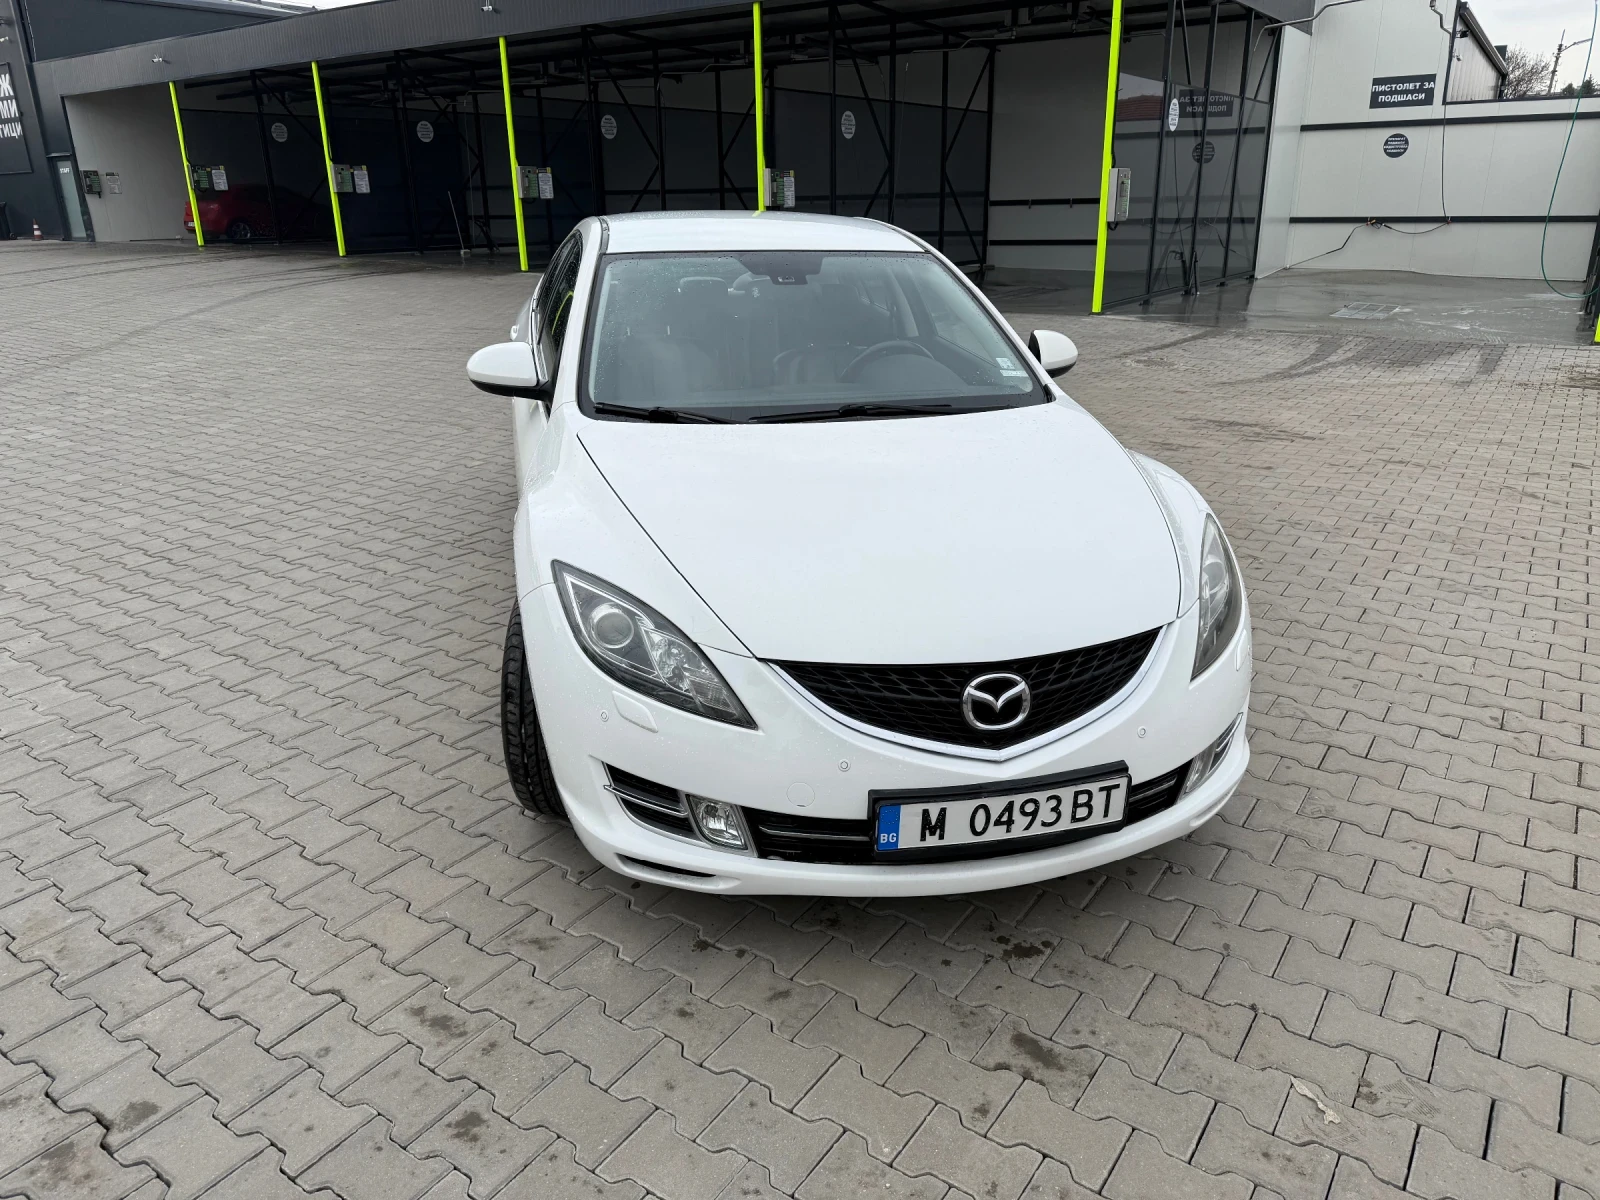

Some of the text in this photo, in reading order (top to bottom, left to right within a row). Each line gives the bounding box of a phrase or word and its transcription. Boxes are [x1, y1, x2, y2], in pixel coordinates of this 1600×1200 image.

[1372, 81, 1435, 92] ПИСТОЛЕТ ЗА
[1378, 93, 1425, 102] ПОДШАСИ
[920, 807, 947, 842] M
[880, 832, 897, 844] BG
